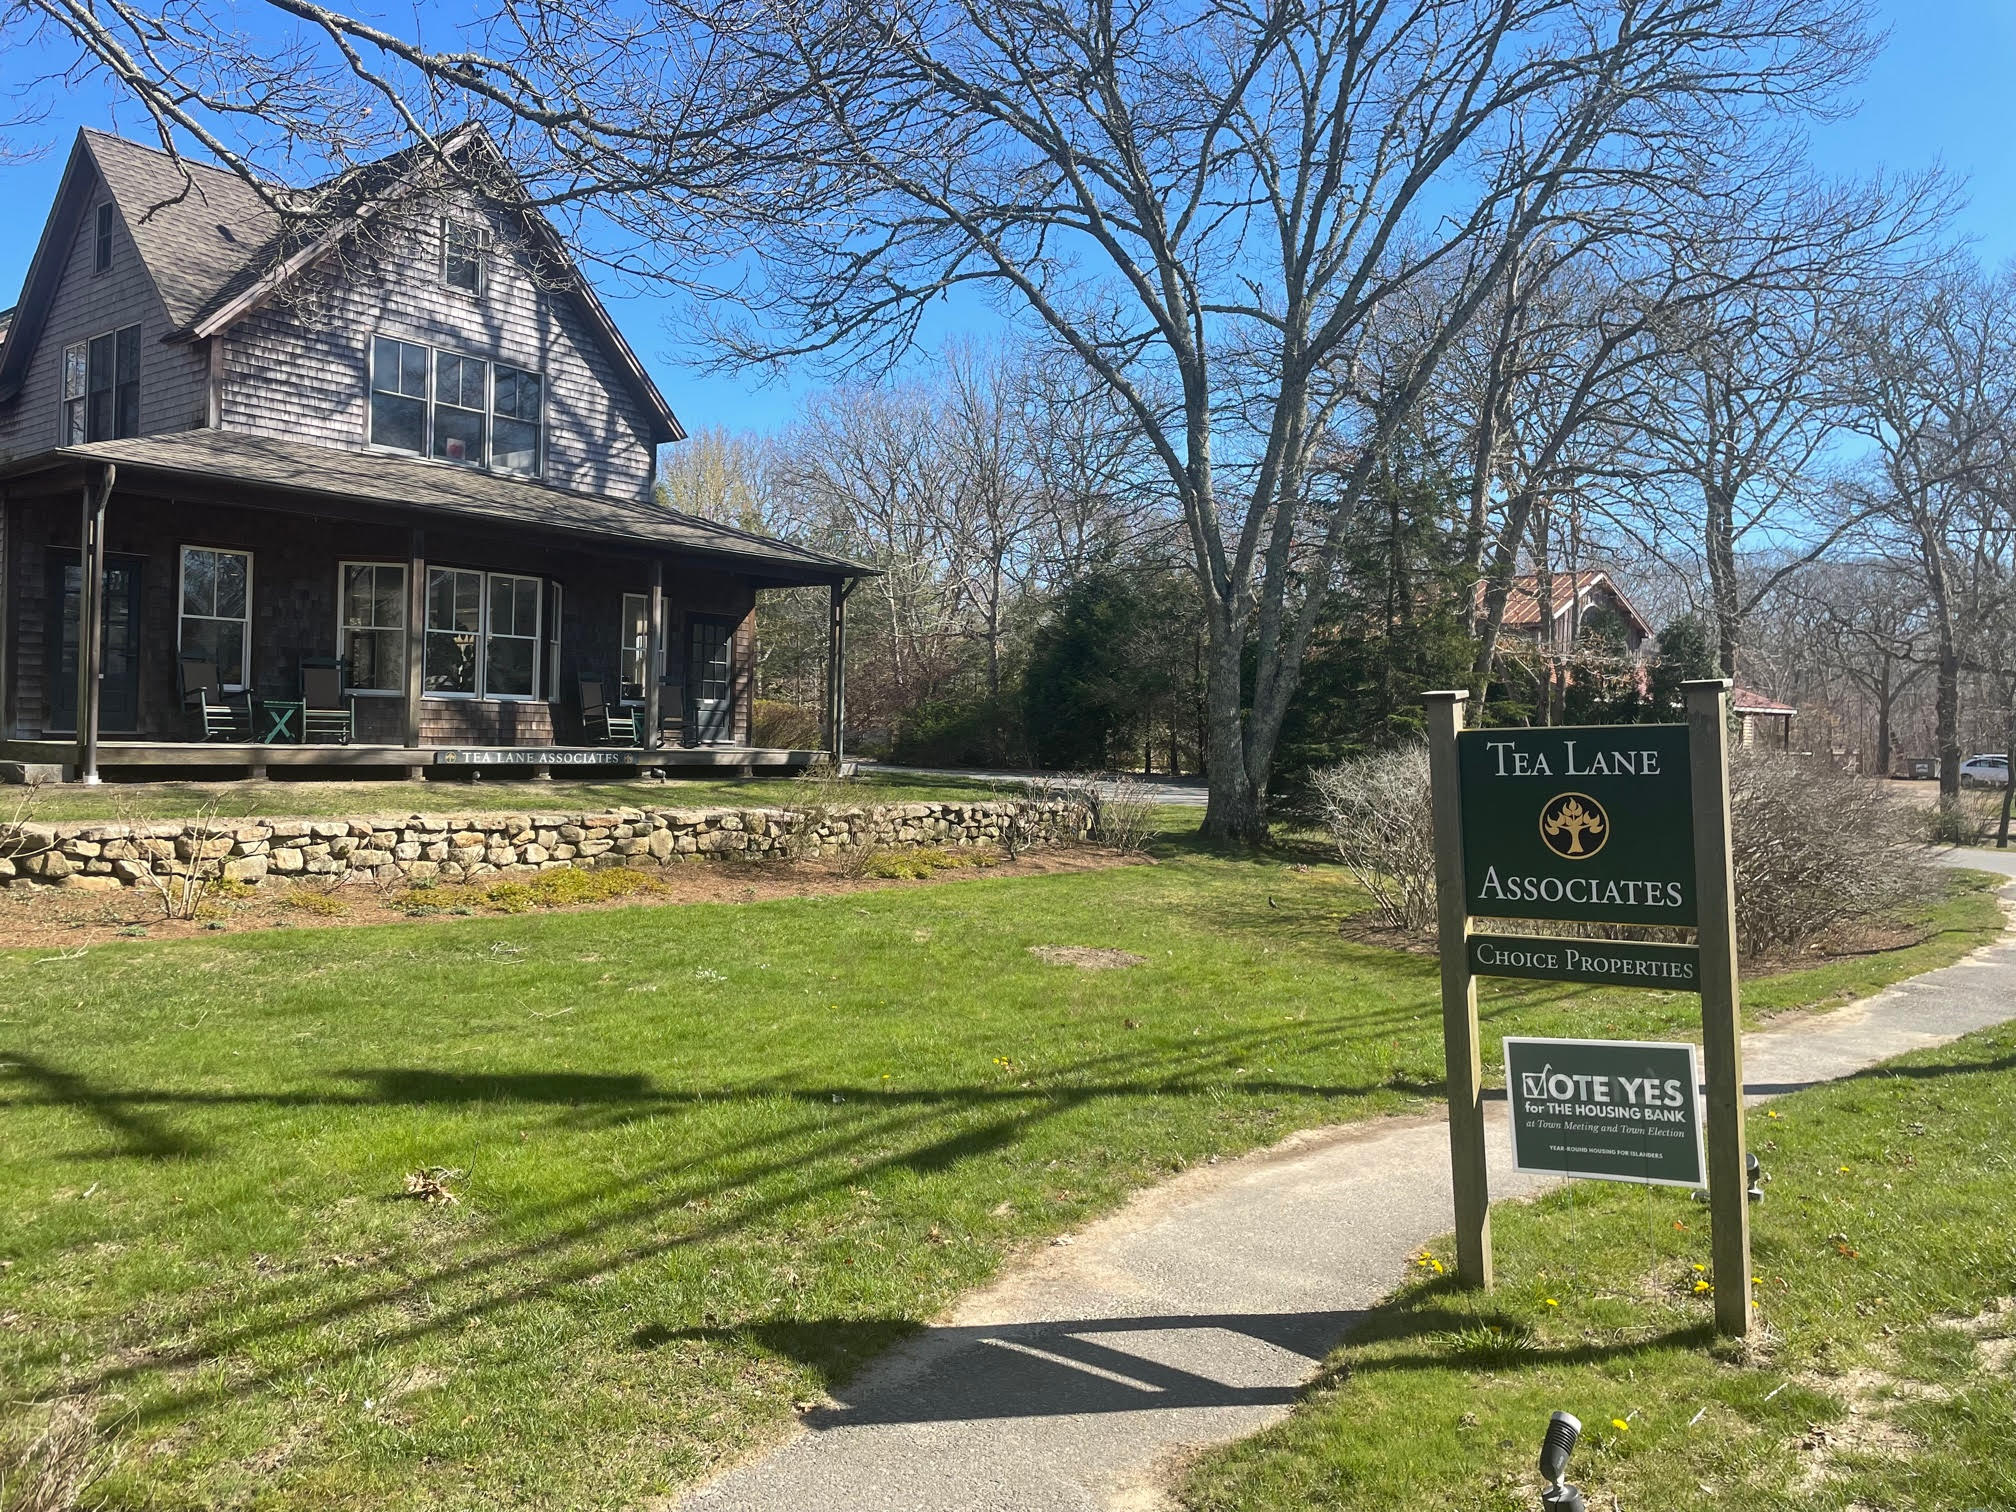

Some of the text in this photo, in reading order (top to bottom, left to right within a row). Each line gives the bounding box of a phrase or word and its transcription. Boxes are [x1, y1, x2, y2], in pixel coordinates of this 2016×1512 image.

[463, 752, 619, 764] TEA LANE ASSOCIATES
[1487, 740, 1661, 776] TEA LANE
[1477, 865, 1683, 907] ASSOCIATES
[1476, 943, 1694, 979] CHOICE PROPERTIES
[1617, 1076, 1684, 1107] YES
[1525, 1101, 1686, 1123] for THE HOUSING BANK
[1526, 1118, 1685, 1139] at Town Meeting and Town Election
[1589, 1147, 1615, 1156] HOUSING
[1617, 1149, 1629, 1157] FOR
